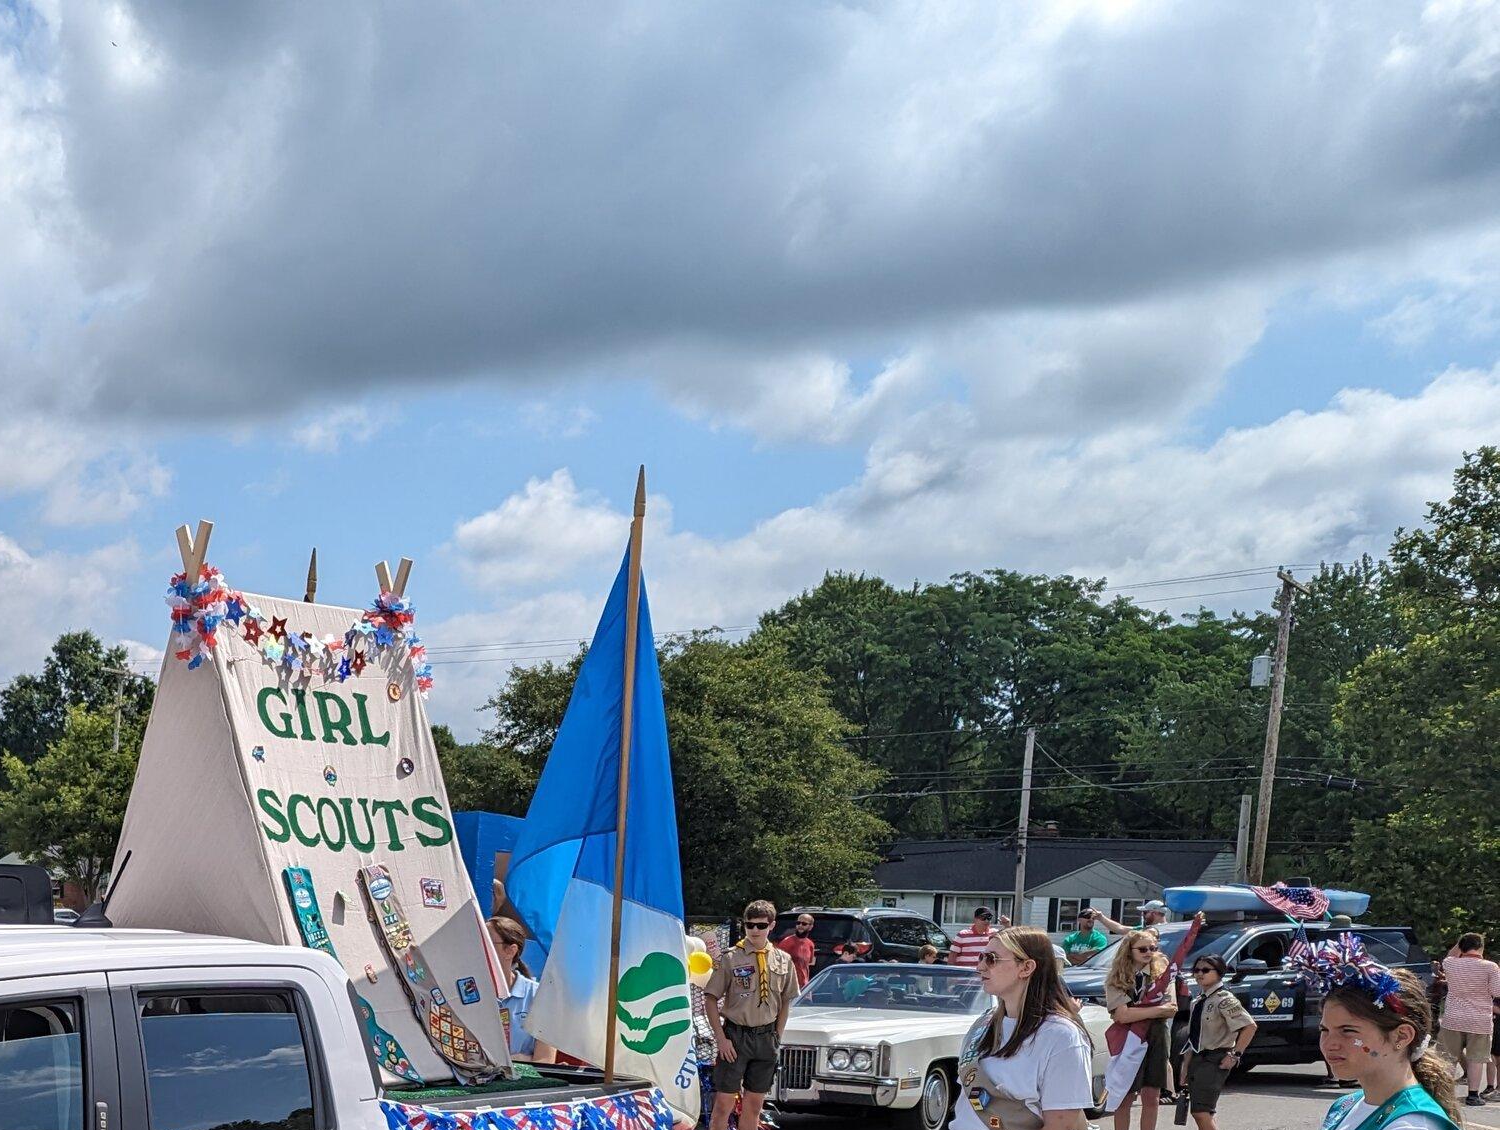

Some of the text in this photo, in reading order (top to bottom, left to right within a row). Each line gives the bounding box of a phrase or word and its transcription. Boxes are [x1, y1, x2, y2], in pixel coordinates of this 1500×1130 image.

[257, 687, 391, 748] GIRL
[257, 788, 453, 853] SCOUTS
[1252, 997, 1264, 1008] 32
[1281, 997, 1294, 1007] 69
